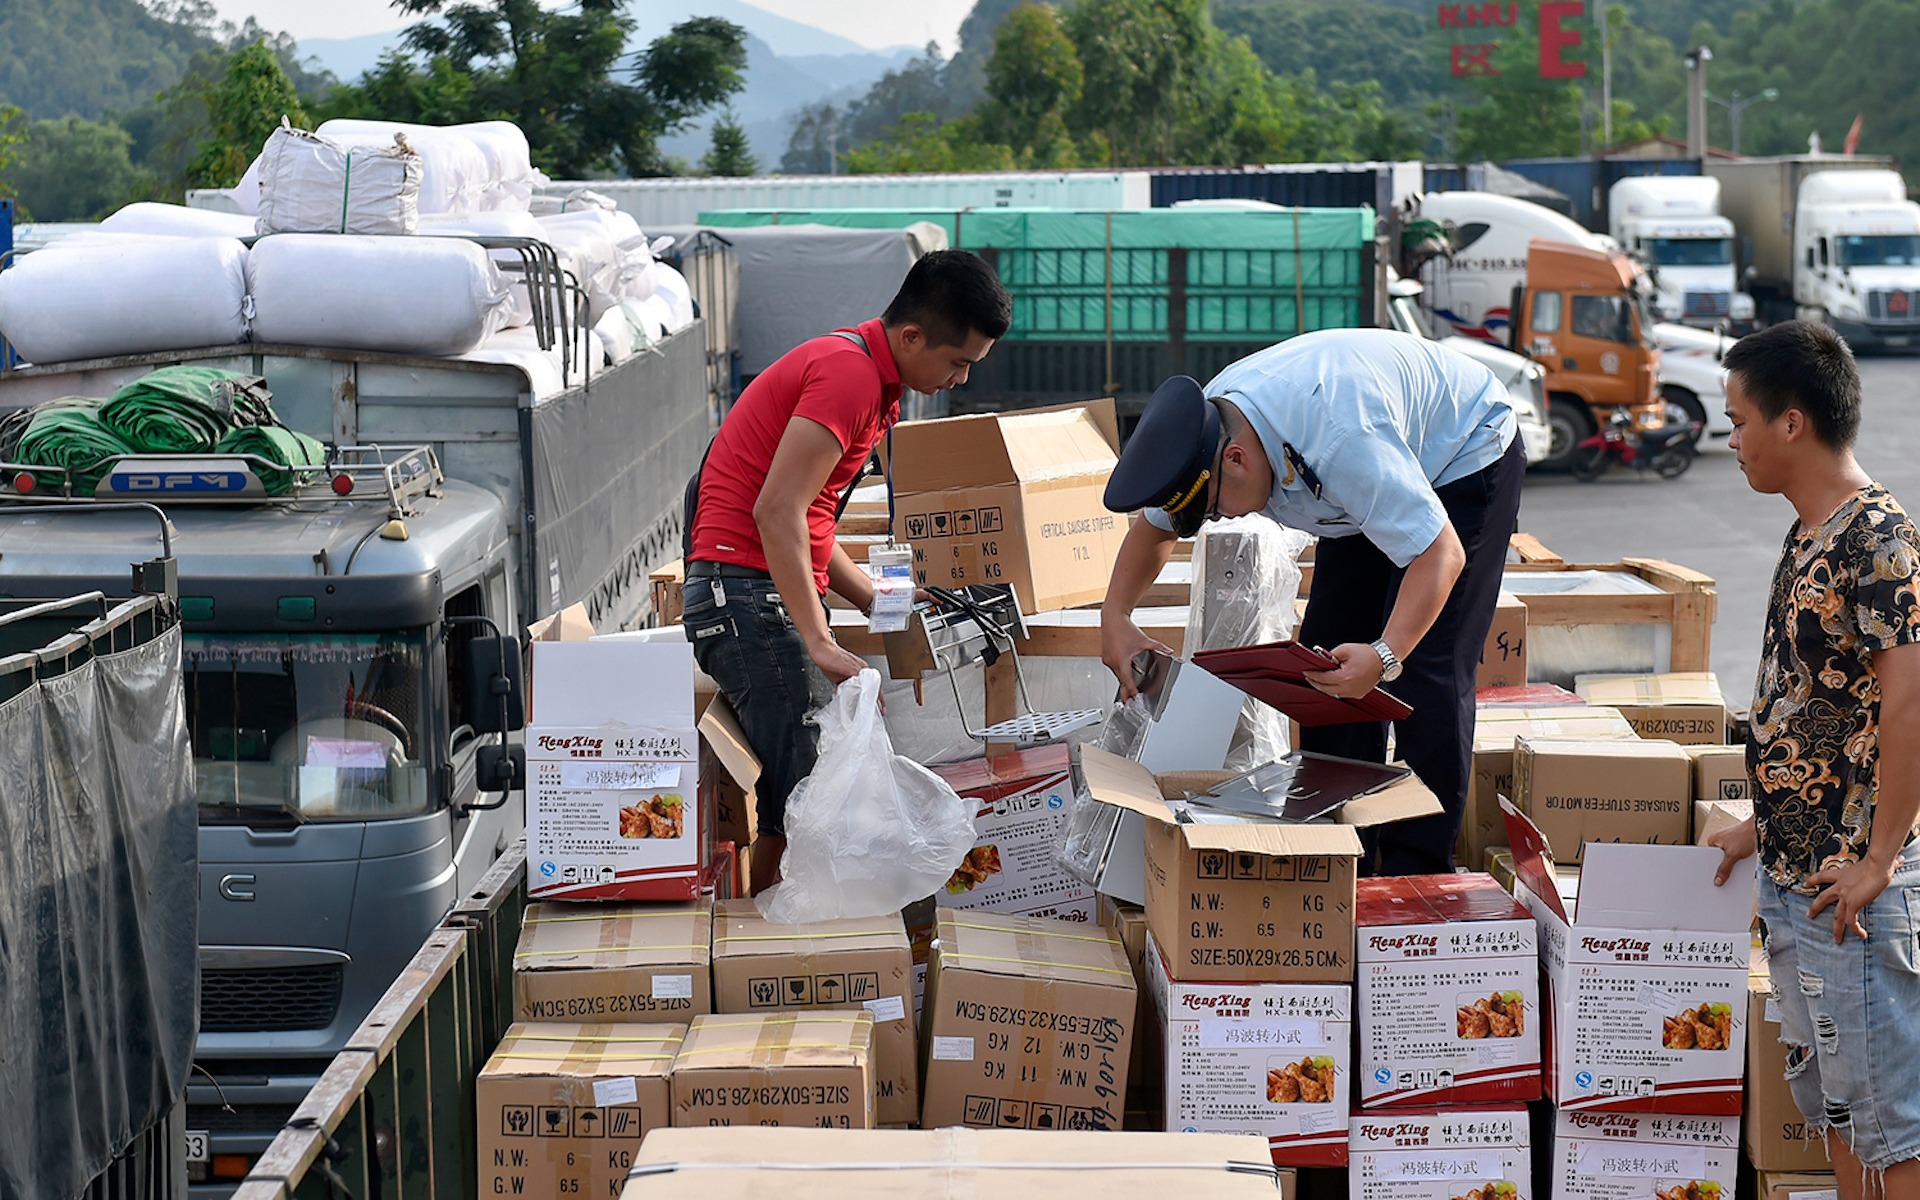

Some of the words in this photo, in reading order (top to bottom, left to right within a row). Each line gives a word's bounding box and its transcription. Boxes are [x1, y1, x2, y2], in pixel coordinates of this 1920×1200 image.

[1439, 3, 1518, 28] KHU
[1538, 2, 1587, 79] E
[128, 475, 228, 489] DFM
[1040, 523, 1067, 539] VERTICAL
[1067, 519, 1091, 535] SAUSAGE
[1092, 516, 1115, 532] STUFFER
[954, 547, 959, 558] 6
[982, 542, 998, 557] KG
[951, 567, 965, 579] 6.5
[985, 563, 1001, 578] KG
[1546, 796, 1582, 809] MOTOR
[1584, 798, 1631, 811] STUFFER
[1634, 801, 1680, 813] SAUSAGE
[1191, 893, 1224, 911] N.W:
[1263, 897, 1270, 909] 6
[1303, 895, 1324, 911] KG
[1191, 922, 1223, 938] G.W:
[1257, 923, 1275, 936] 6.5
[1303, 923, 1323, 939] KG
[1452, 945, 1486, 954] HX-81
[988, 1033, 1009, 1051] KG
[1225, 1029, 1301, 1044] 冯波转小武
[1024, 1036, 1041, 1054] 12
[1060, 1041, 1090, 1060] G.W:
[984, 1061, 1005, 1079] KG
[1021, 1066, 1036, 1082] 11
[1057, 1068, 1087, 1087] N.W:
[1444, 1136, 1479, 1144] HX-81
[1653, 1132, 1688, 1140] HX-81
[494, 1149, 529, 1167] N.W:
[567, 1152, 575, 1166] 6
[609, 1151, 629, 1168] KG
[1602, 1158, 1679, 1173] 冯波转小武
[1401, 1160, 1478, 1175] 冯波转小武
[494, 1176, 525, 1194] G.W
[560, 1178, 579, 1193] 6.5
